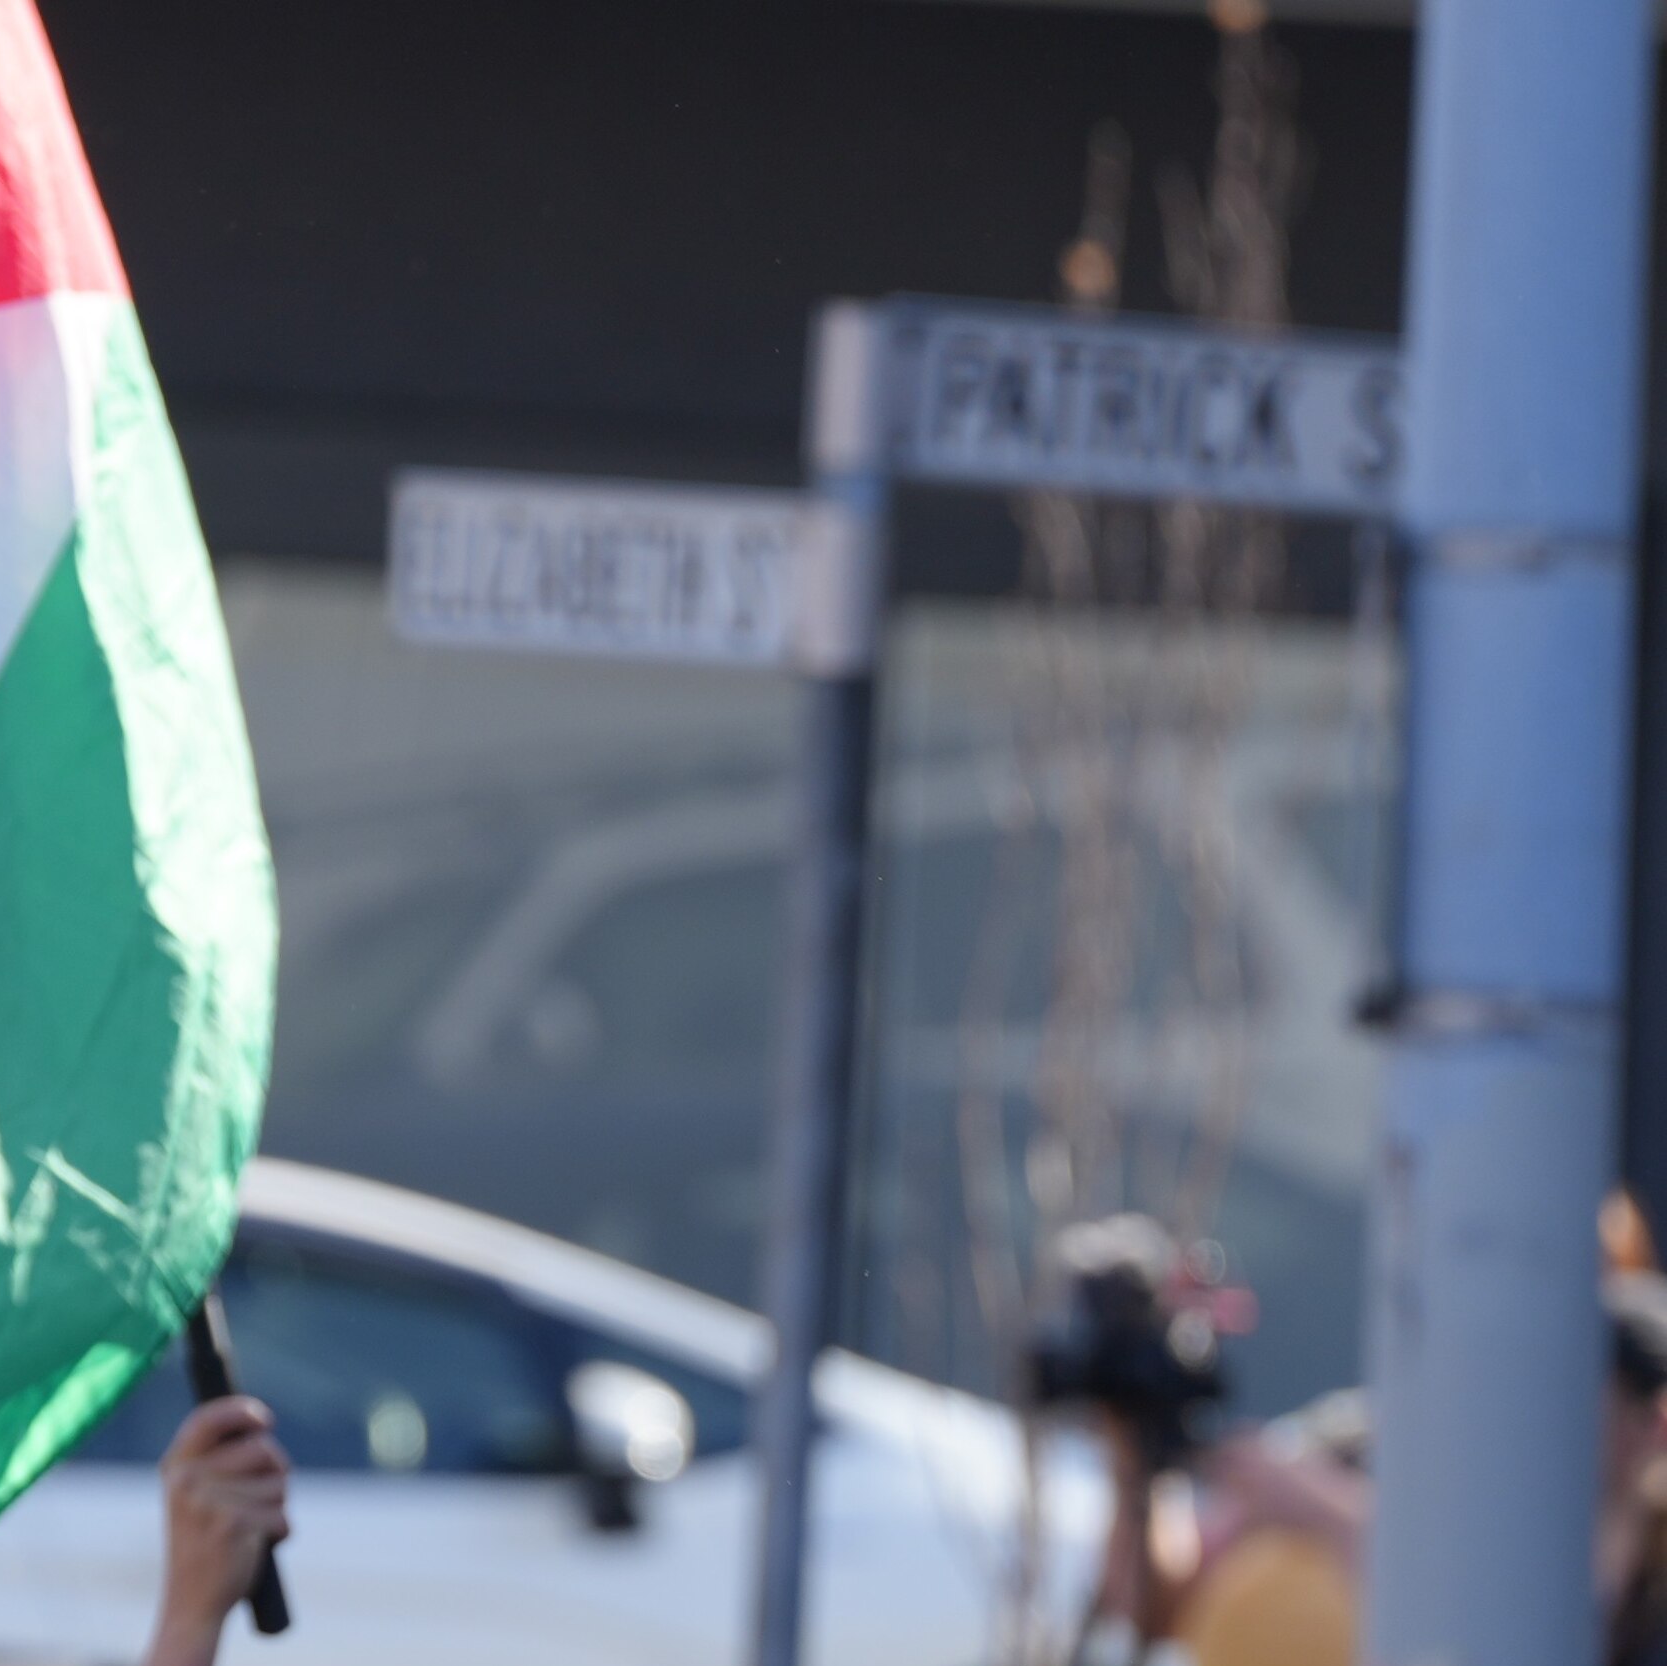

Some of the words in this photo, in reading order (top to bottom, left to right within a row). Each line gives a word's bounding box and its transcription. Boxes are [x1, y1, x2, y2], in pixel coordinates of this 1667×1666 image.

[935, 334, 1301, 472] PATRICK
[1341, 360, 1409, 486] S
[397, 508, 709, 630] ELIZABETH
